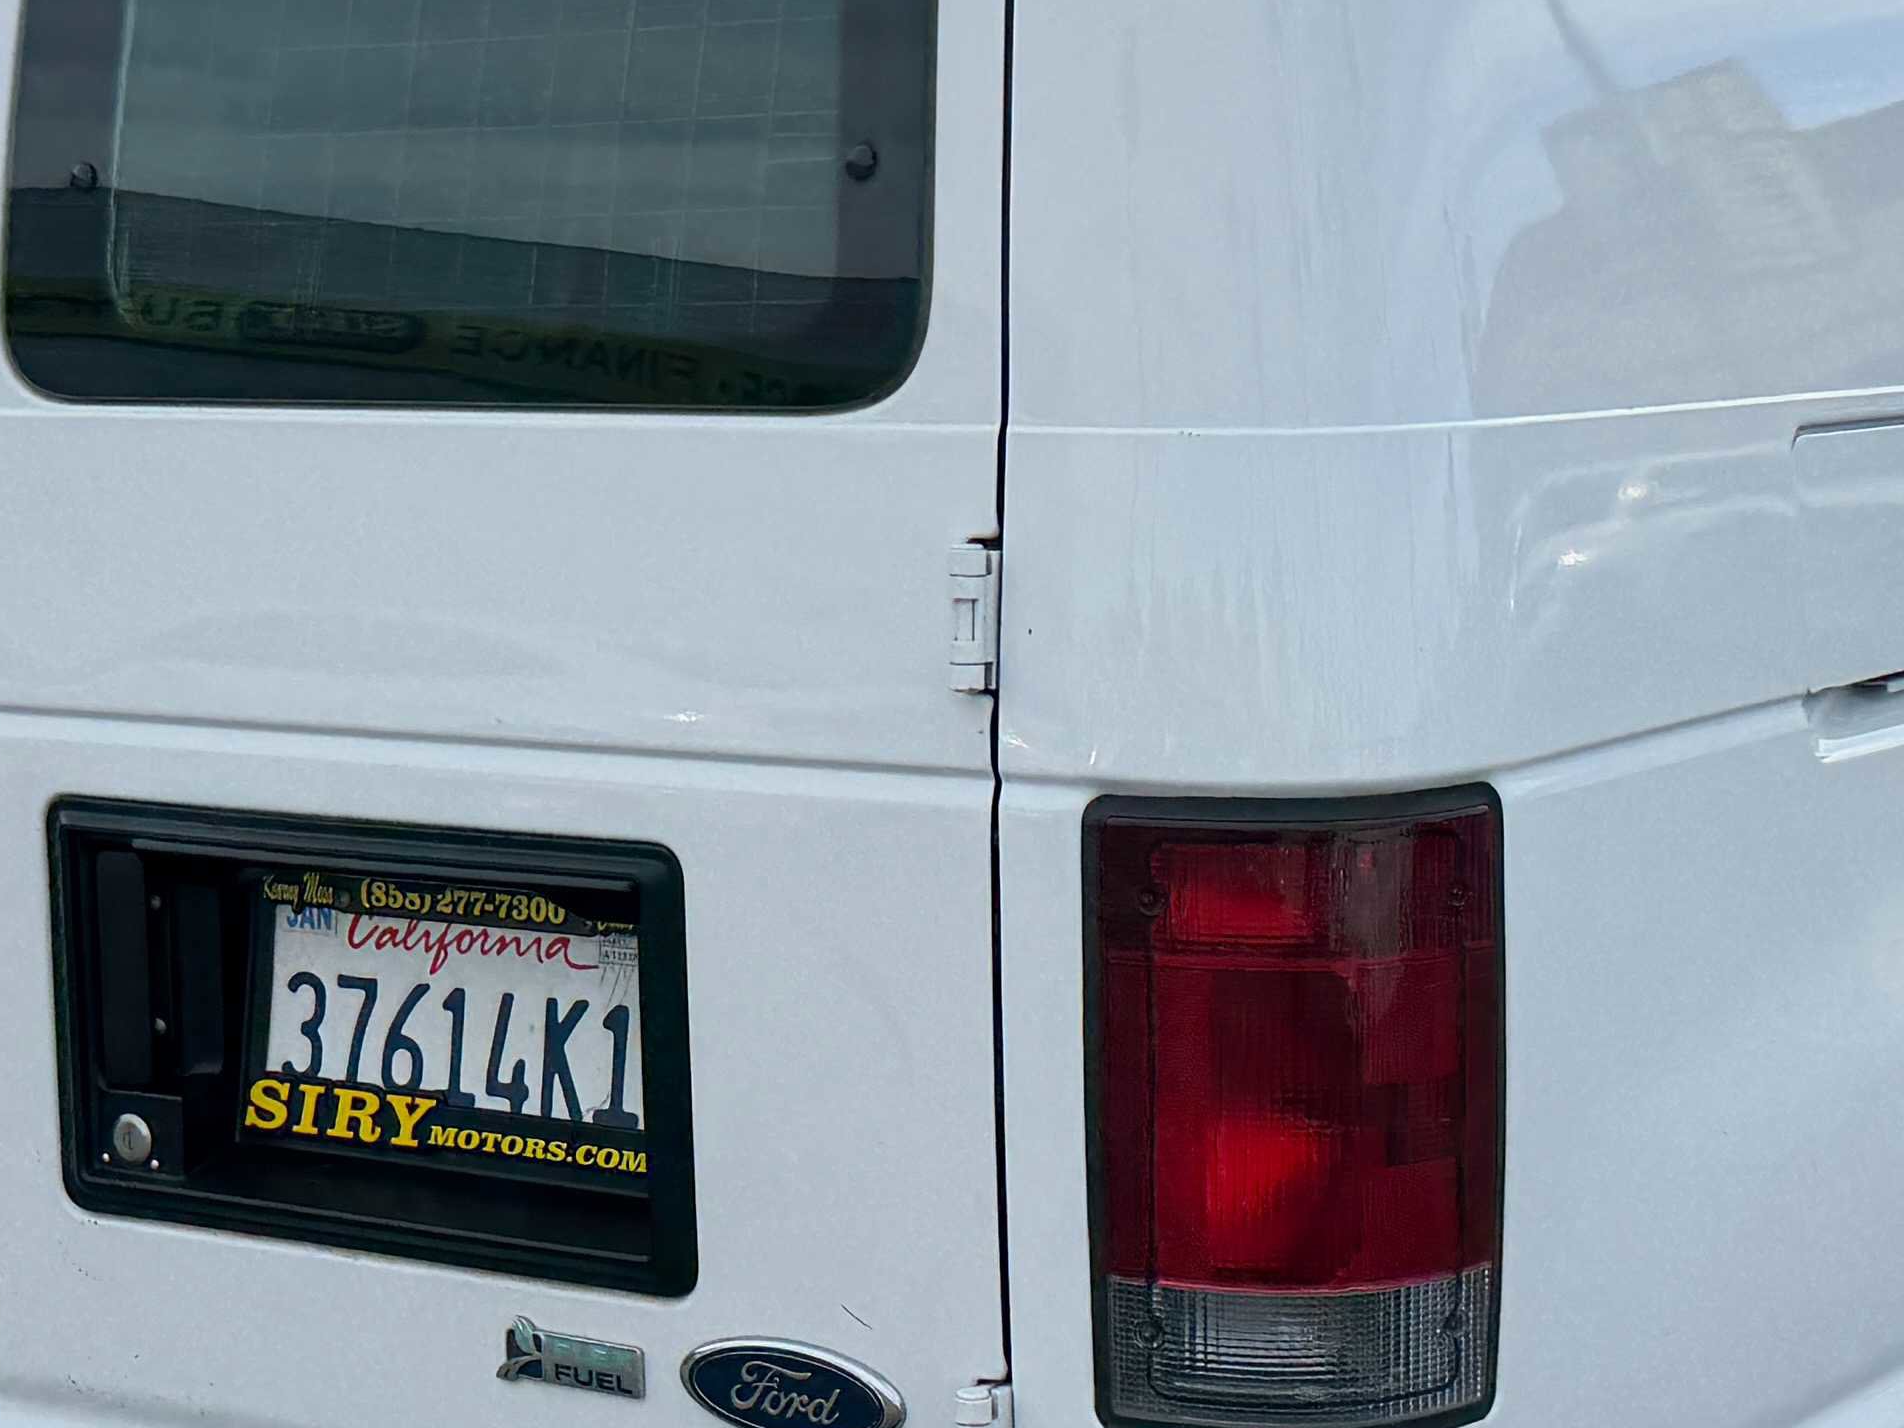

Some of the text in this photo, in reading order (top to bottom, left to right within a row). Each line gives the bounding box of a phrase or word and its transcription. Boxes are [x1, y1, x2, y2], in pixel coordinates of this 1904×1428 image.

[346, 913, 600, 975] California
[281, 970, 640, 1130] 37614K1
[244, 1078, 648, 1173] SIRY MOTORS.COM
[554, 1362, 634, 1395] FUEL
[731, 1360, 842, 1426] Ford
